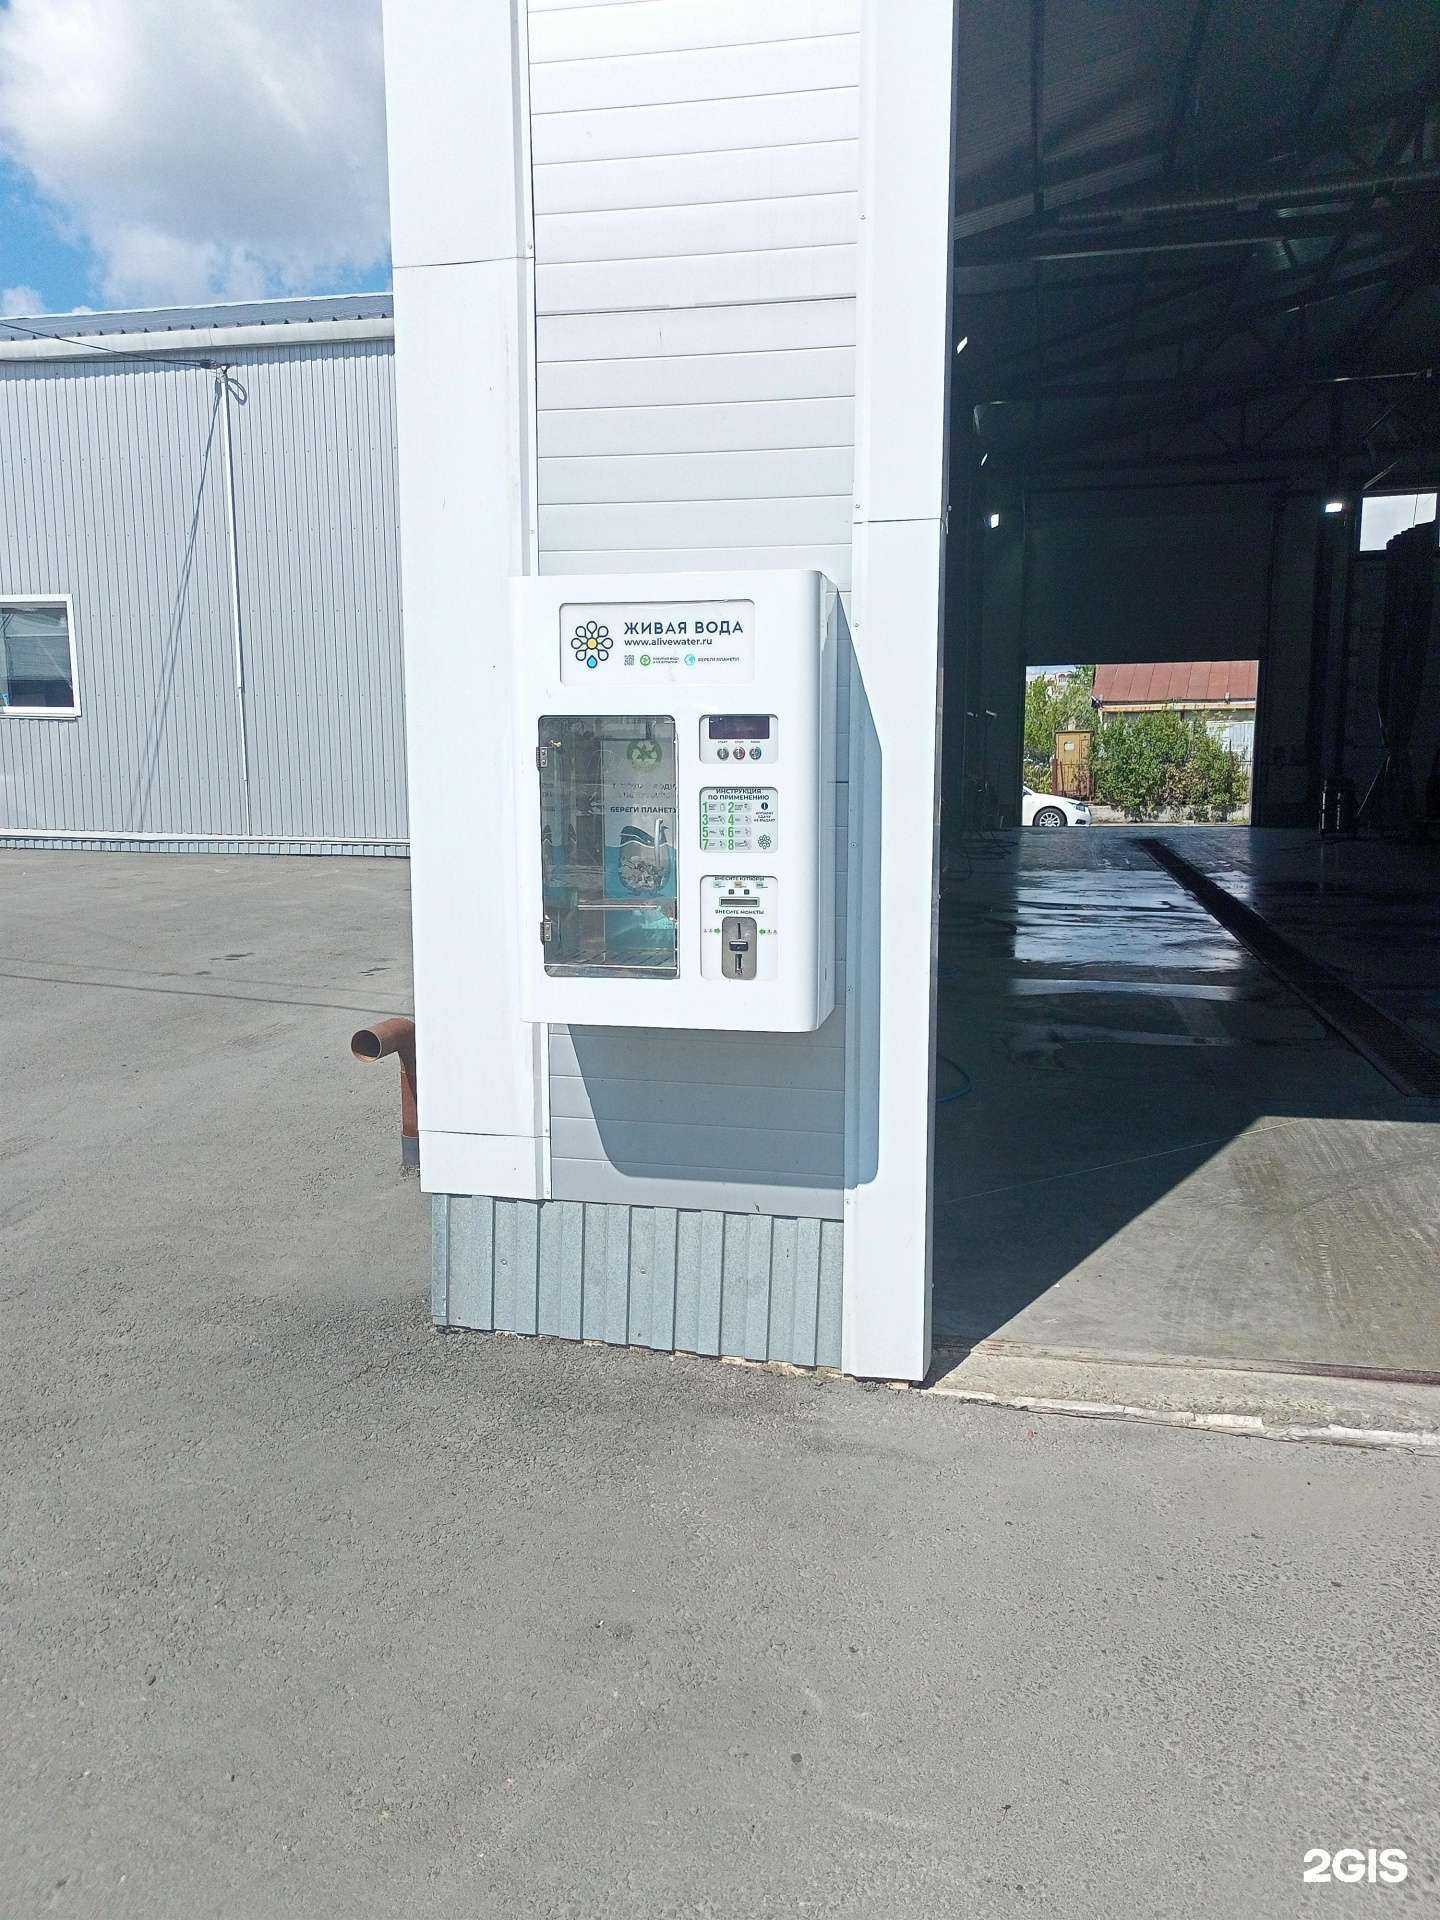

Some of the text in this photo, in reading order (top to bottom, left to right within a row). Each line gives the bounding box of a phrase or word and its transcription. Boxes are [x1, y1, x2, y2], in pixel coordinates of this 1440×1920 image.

[624, 620, 744, 635] ЖИВАЯ ВОДА
[624, 637, 713, 646] www.alivewater.ru
[702, 802, 709, 813] 1
[728, 802, 735, 813] 2
[702, 814, 709, 825] 3
[728, 814, 735, 826] 4
[702, 826, 709, 838] 5
[728, 826, 735, 838] 6
[702, 839, 709, 850] 7
[728, 839, 735, 850] 8
